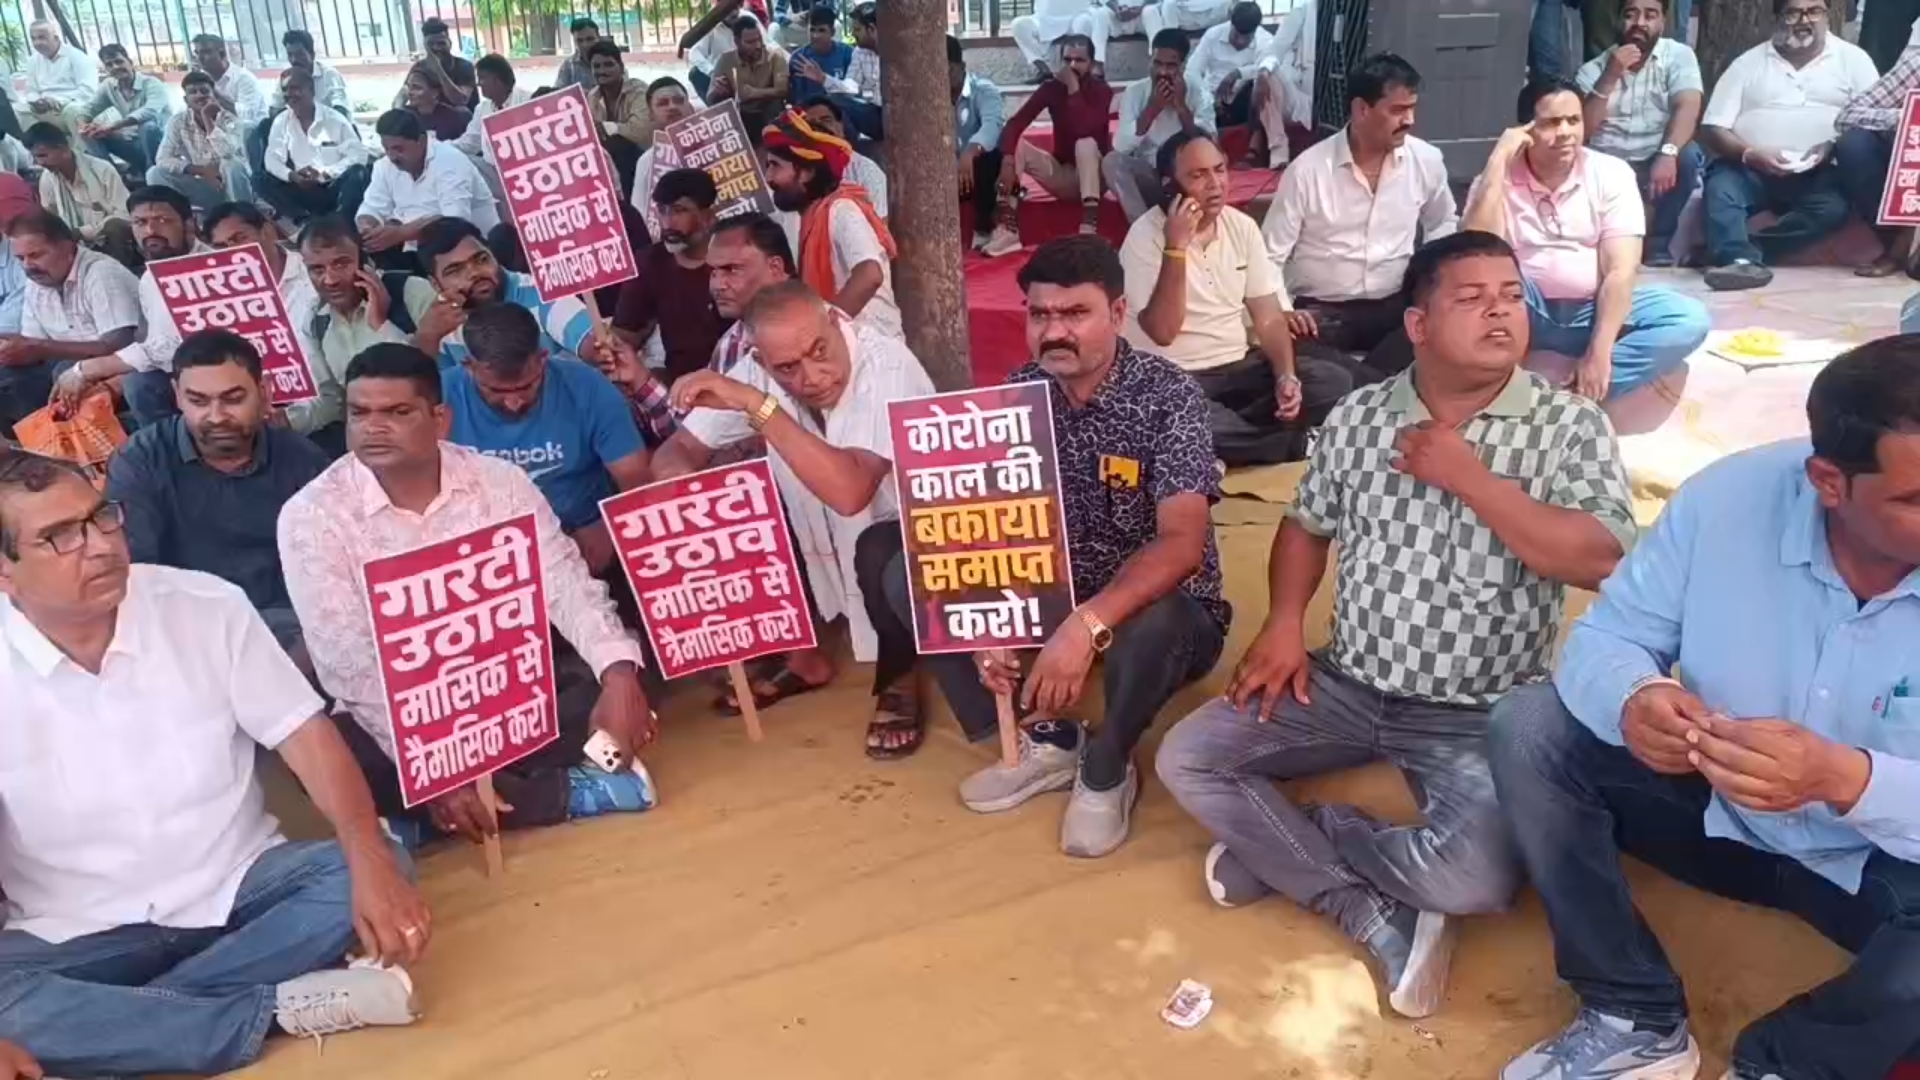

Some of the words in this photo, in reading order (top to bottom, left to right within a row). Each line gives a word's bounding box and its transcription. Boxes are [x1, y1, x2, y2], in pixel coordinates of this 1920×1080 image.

[491, 95, 590, 162] गारंटी
[676, 112, 733, 147] कोरोना
[684, 142, 720, 168] काल
[719, 130, 743, 153] की
[504, 144, 600, 200] उठाव
[703, 150, 752, 183] काया
[715, 171, 759, 203] माप्त
[518, 194, 590, 243] मासिक
[593, 180, 615, 221] से
[158, 252, 266, 300] गारंटी
[532, 240, 598, 291] त्रैमासिक
[593, 228, 626, 271] करो
[172, 291, 278, 332] उठाव
[266, 320, 294, 354] से
[271, 357, 308, 393] करो
[903, 400, 1032, 454] कोरोना
[906, 462, 987, 501] काल
[992, 446, 1043, 493] की
[614, 470, 769, 539] गारंटी
[910, 496, 1051, 546] बकाया
[374, 526, 531, 618] गारंटी
[627, 518, 778, 578] उठाव
[917, 545, 1054, 592] समाप्त
[642, 569, 753, 620] मासिक
[755, 555, 791, 597] से
[944, 589, 1044, 640] करो!
[384, 584, 537, 672] उठाव
[657, 614, 754, 667] त्रैमासिक
[753, 600, 801, 643] करो
[394, 652, 508, 728] मासिक
[513, 630, 545, 684] से
[404, 713, 504, 790] त्रैमासिक
[504, 685, 548, 745] करो
